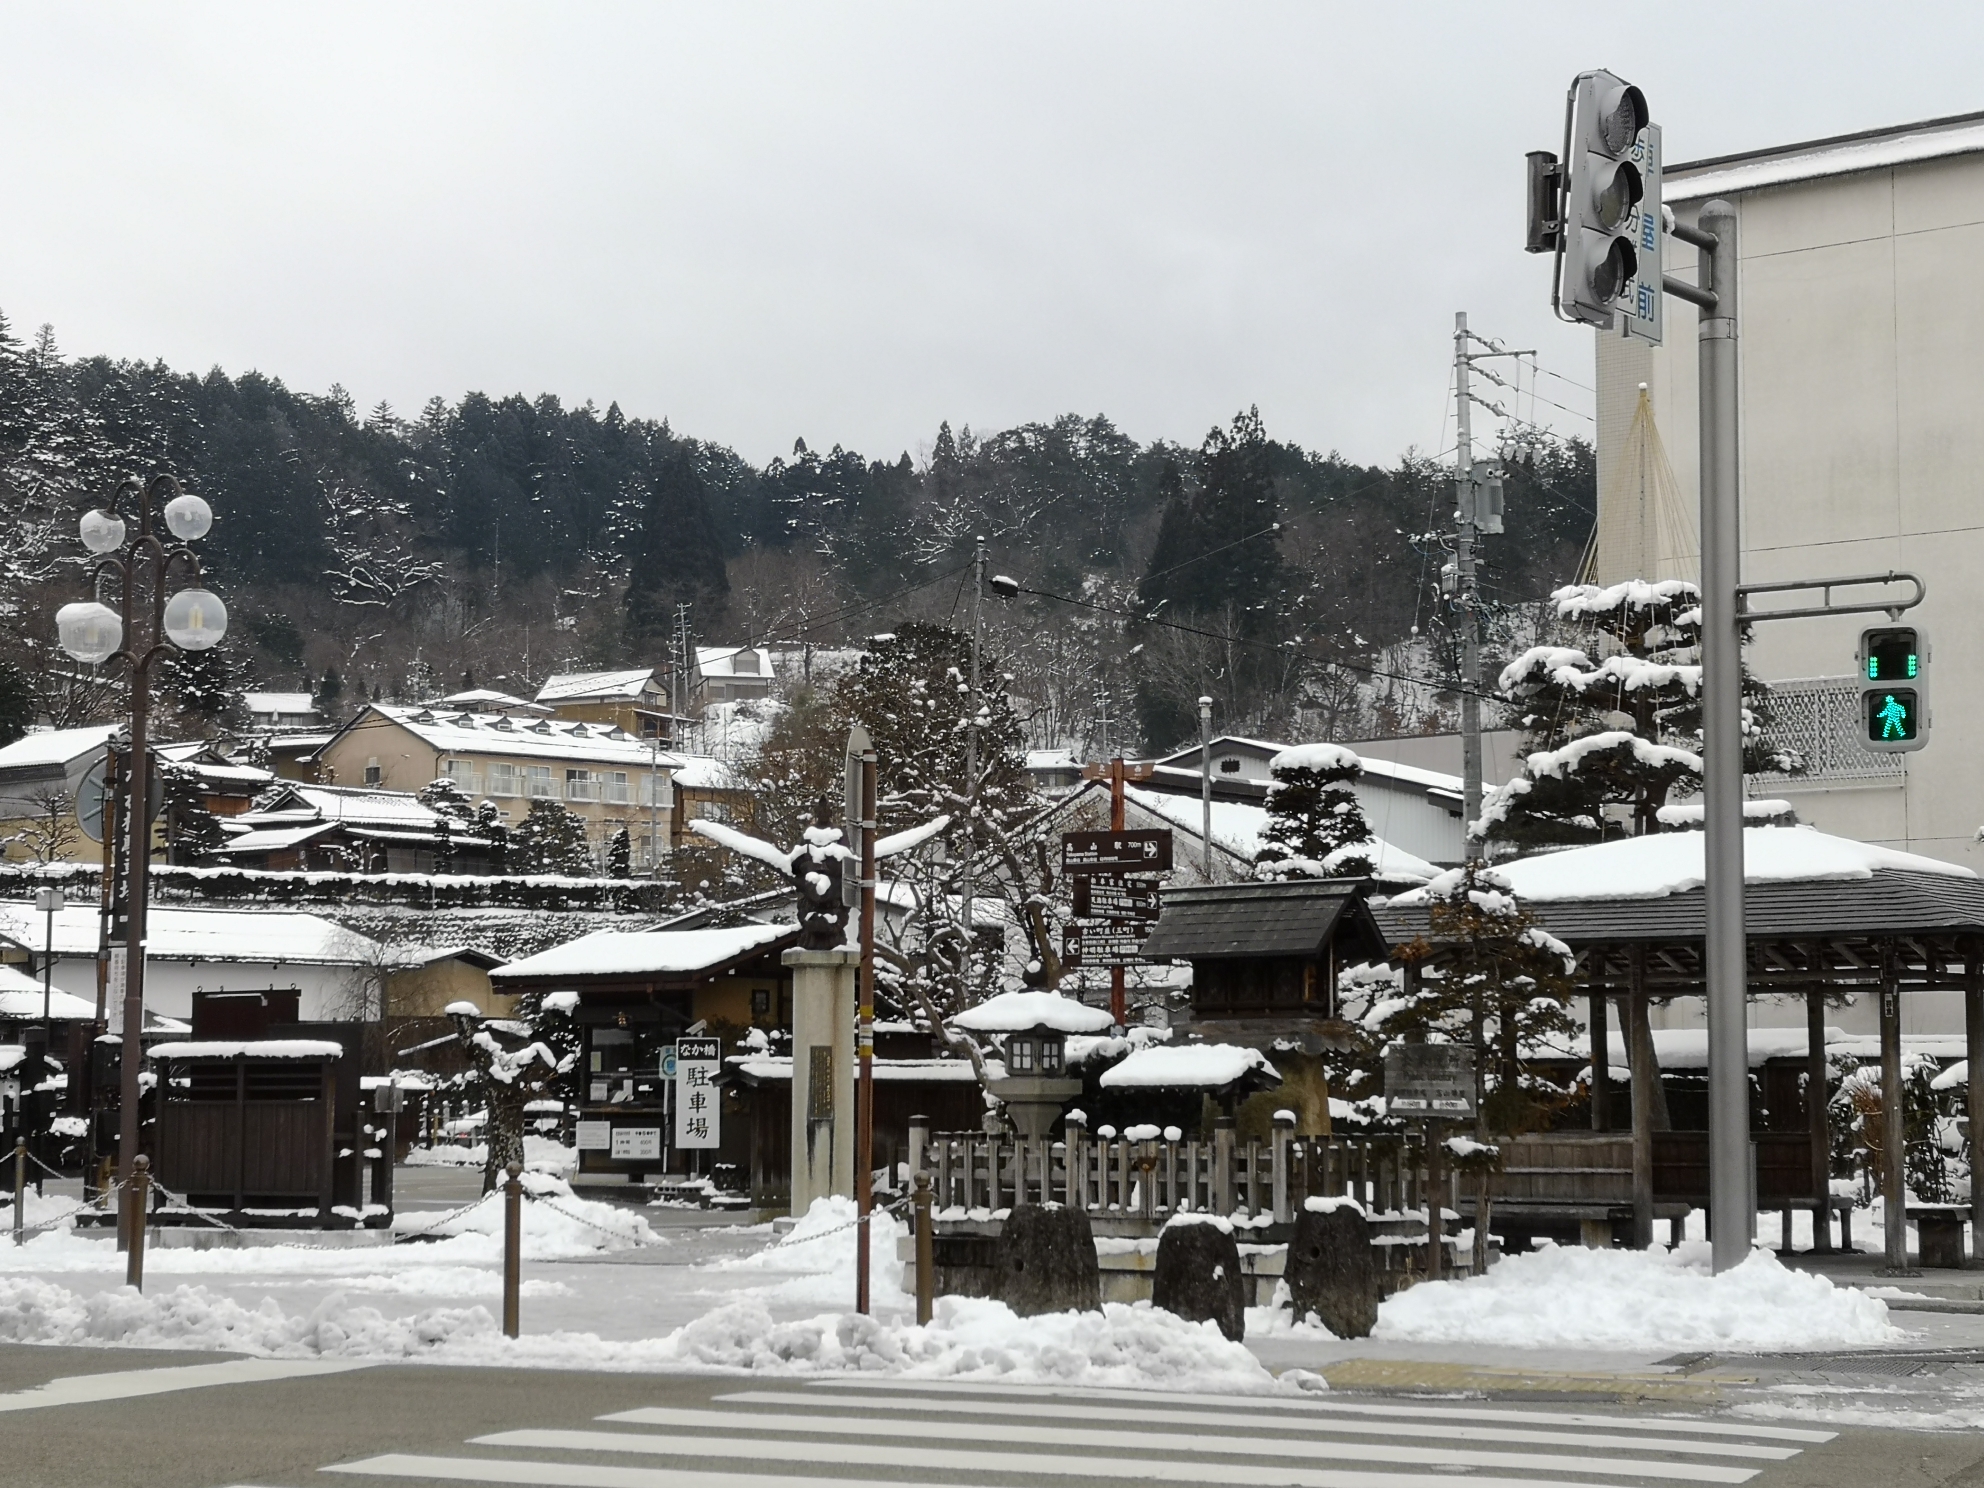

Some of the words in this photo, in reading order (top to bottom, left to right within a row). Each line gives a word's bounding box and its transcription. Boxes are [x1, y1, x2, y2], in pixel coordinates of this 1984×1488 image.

[1127, 841, 1142, 849] 700m
[680, 1043, 717, 1057] なか橋
[685, 1065, 709, 1140] 駐車場
